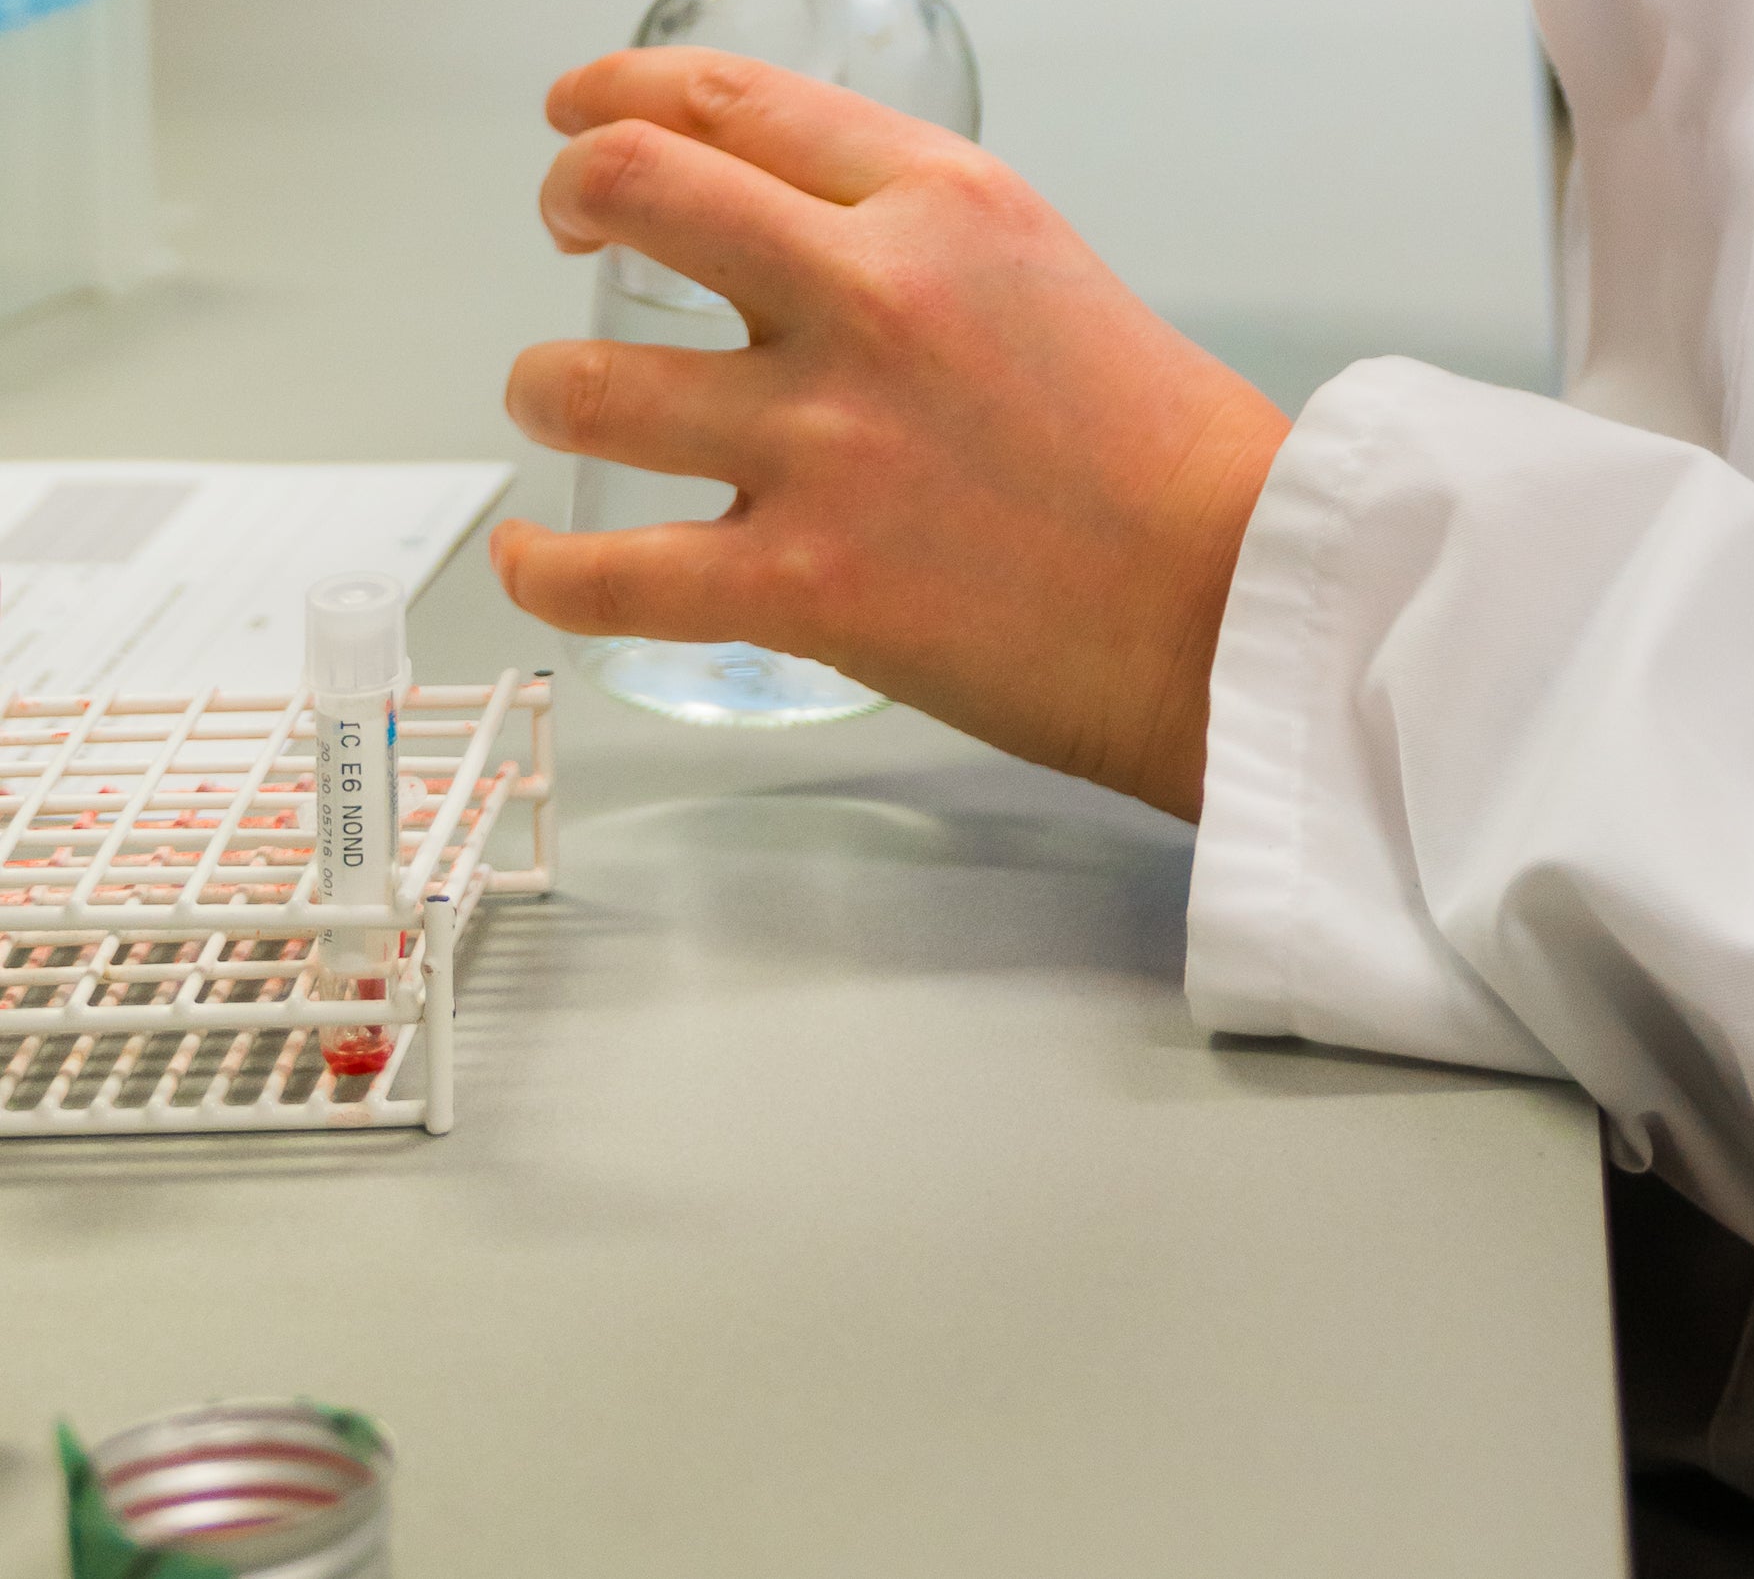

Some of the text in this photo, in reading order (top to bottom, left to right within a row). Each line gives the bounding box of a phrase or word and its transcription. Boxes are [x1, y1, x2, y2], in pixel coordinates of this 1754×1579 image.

[340, 720, 364, 868] IC E6 NOND
